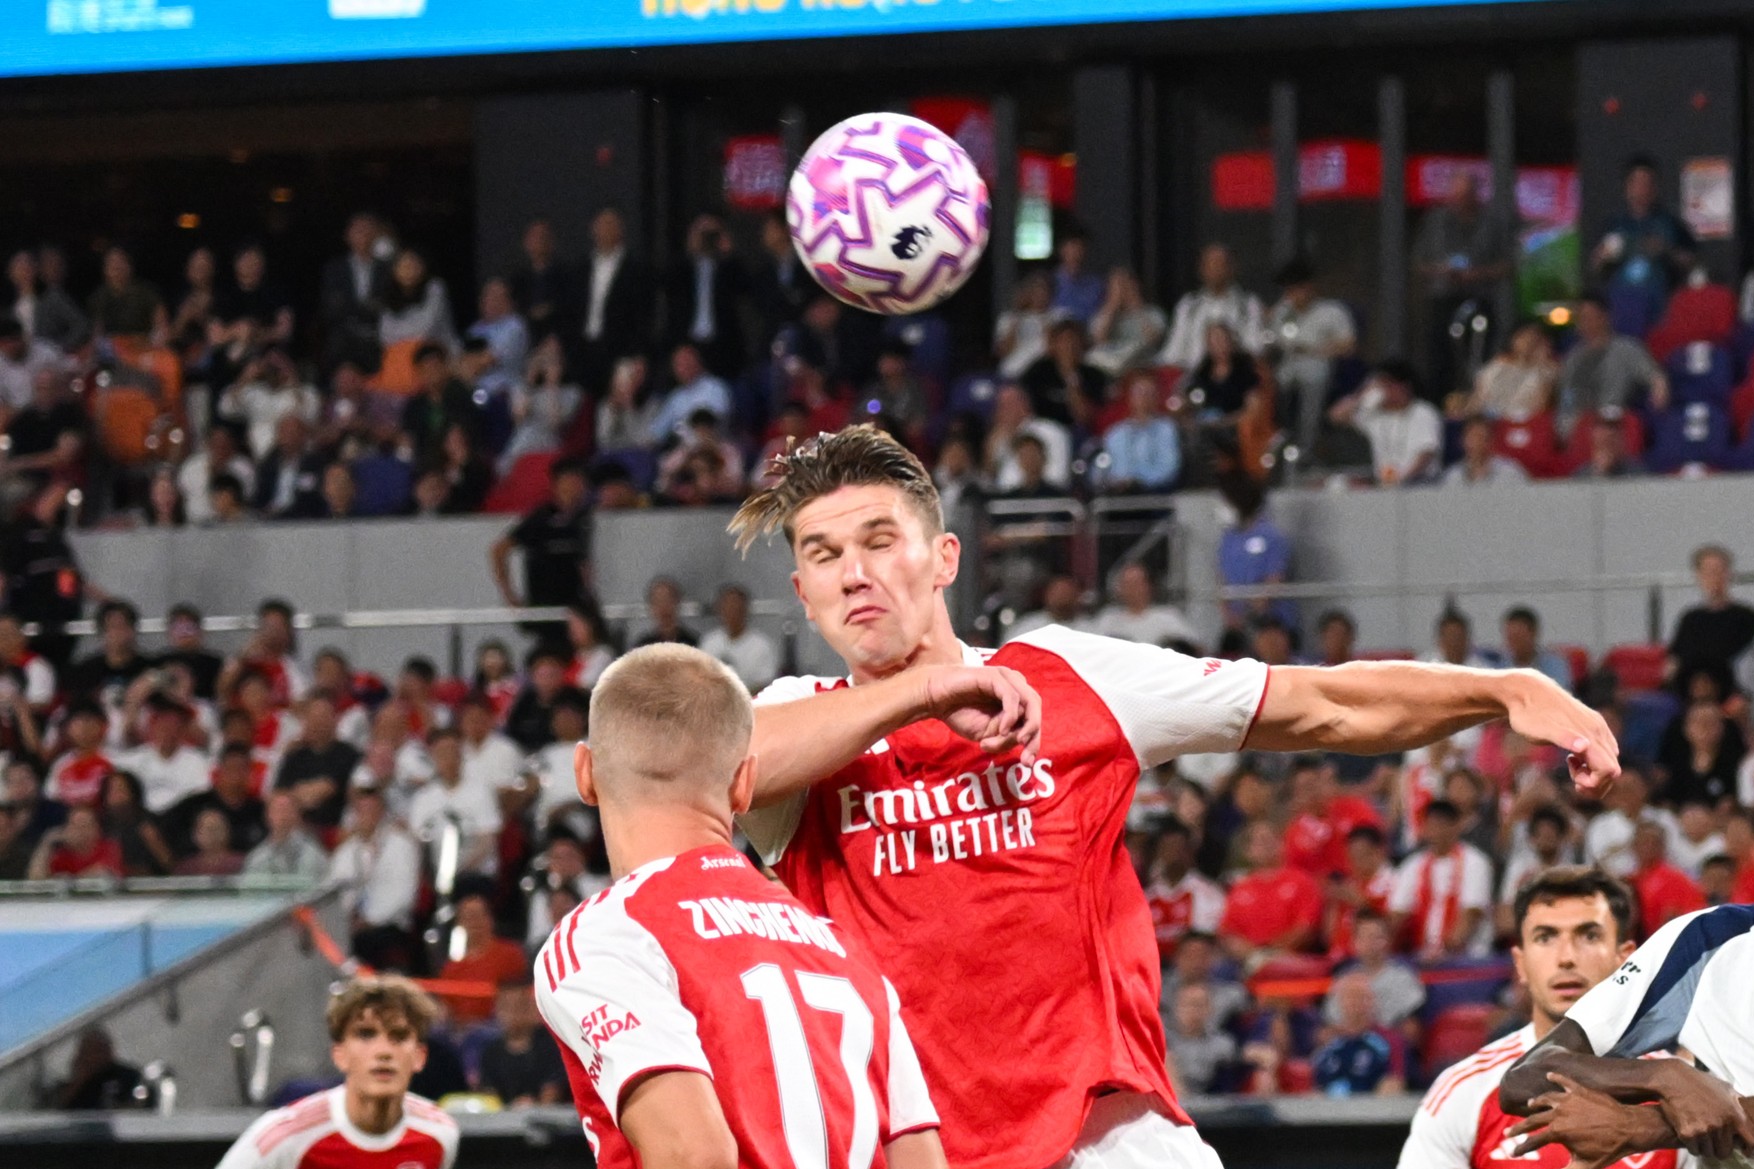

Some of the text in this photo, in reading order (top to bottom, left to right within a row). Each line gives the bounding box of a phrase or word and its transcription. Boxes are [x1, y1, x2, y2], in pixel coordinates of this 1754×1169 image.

[836, 758, 1056, 834] Emirates
[873, 807, 1036, 877] FLY BETTER
